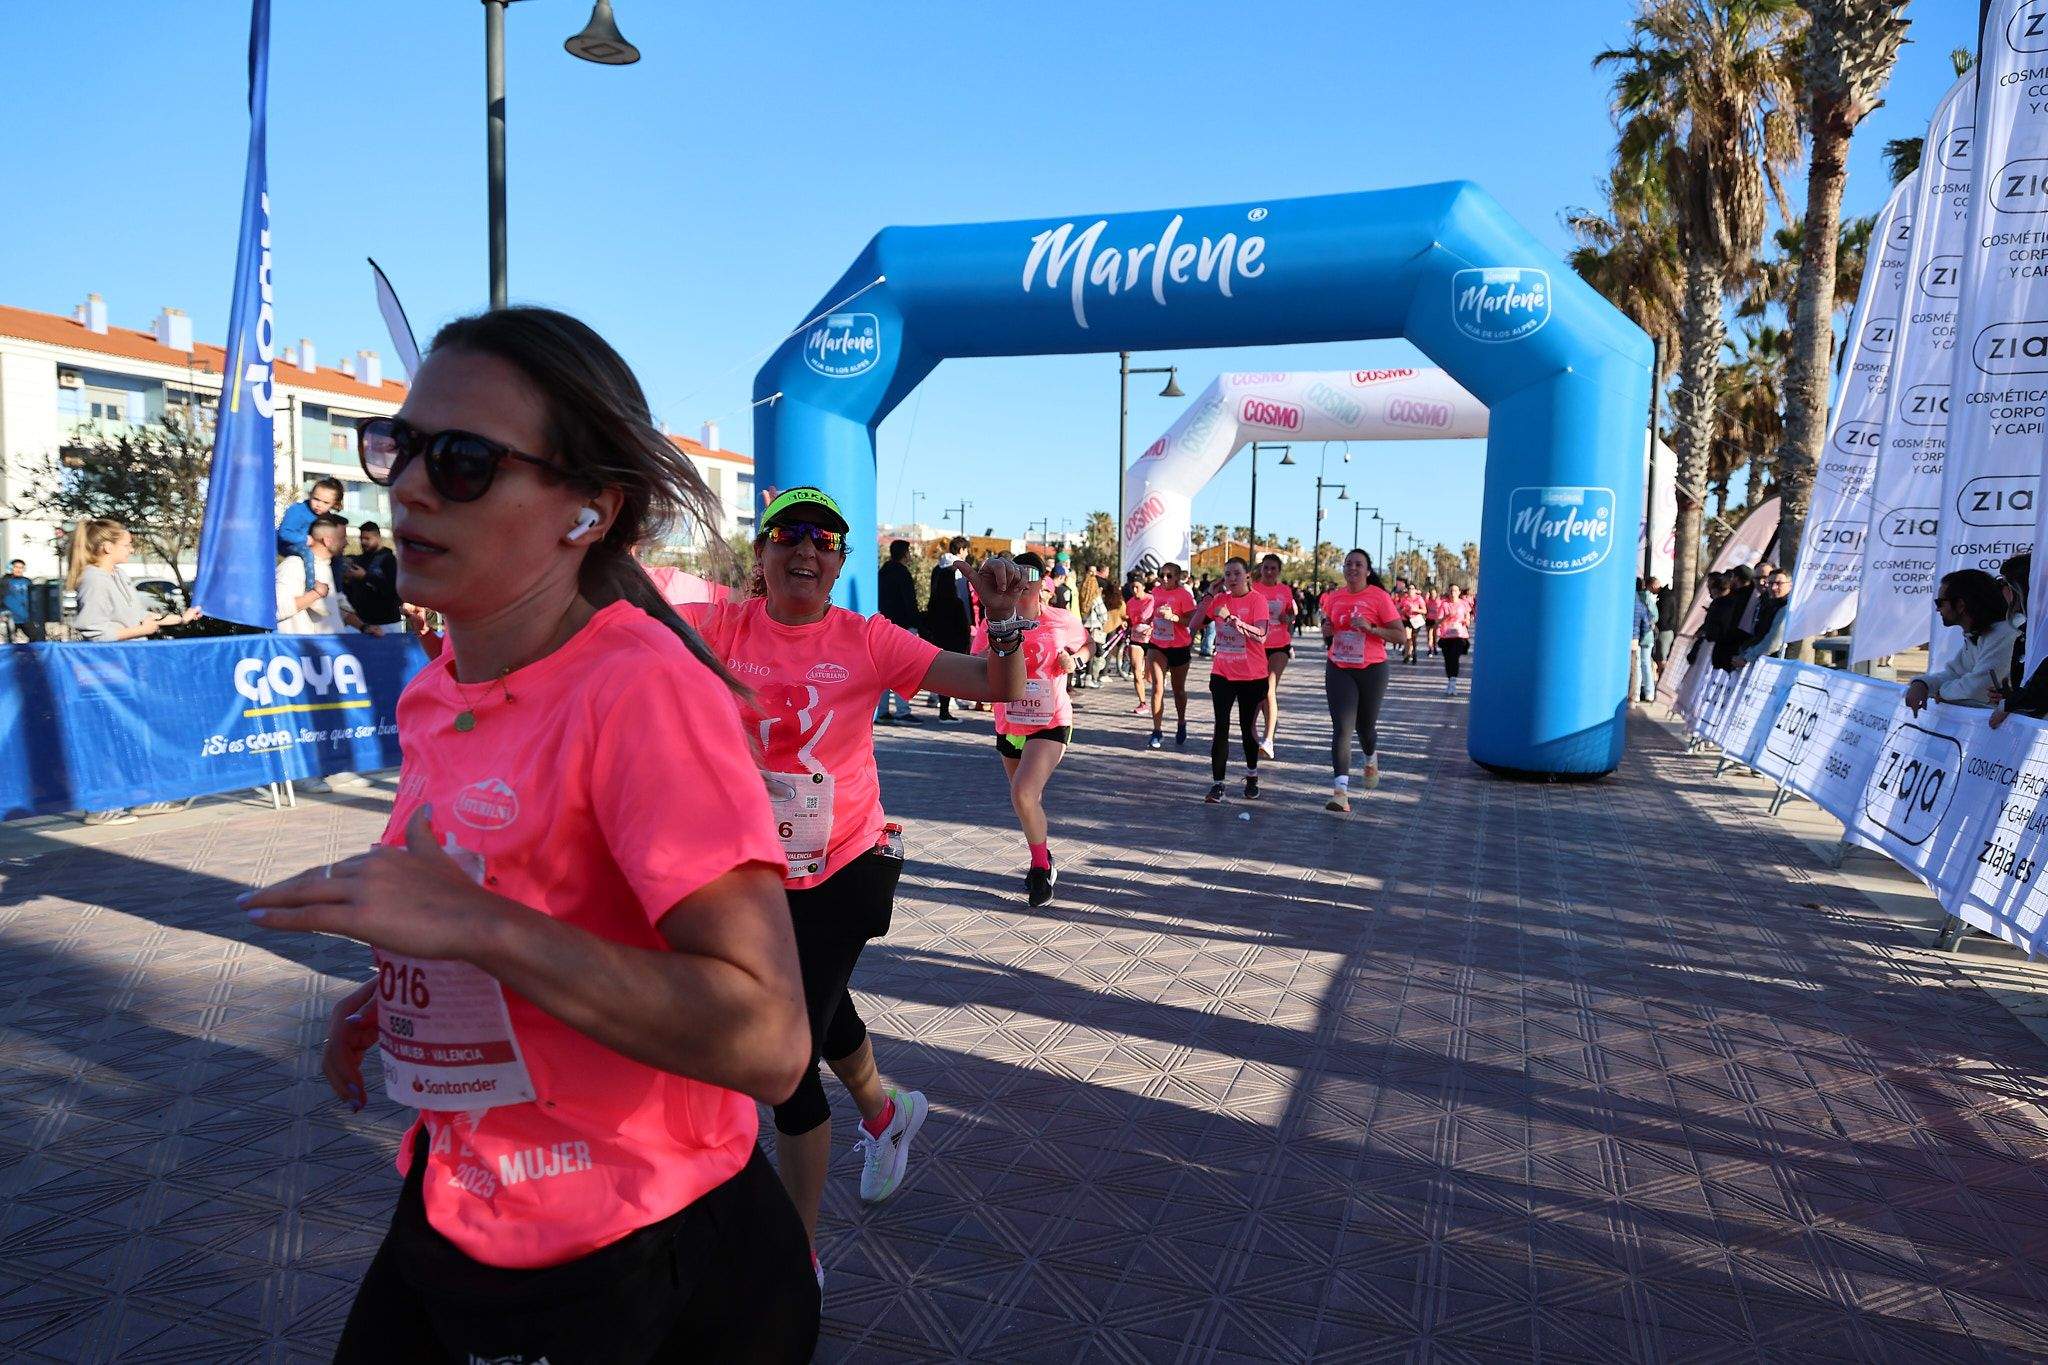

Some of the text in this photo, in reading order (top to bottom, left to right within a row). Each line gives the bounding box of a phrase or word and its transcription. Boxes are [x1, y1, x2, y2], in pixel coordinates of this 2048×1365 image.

[1022, 214, 1266, 330] Marlene
[1459, 283, 1545, 323] Marlene
[809, 328, 874, 360] Marlene
[1243, 400, 1299, 429] COSMO
[1389, 399, 1449, 427] COSMO
[1992, 424, 2001, 435] Y
[1514, 506, 1607, 550] Marlene
[1551, 559, 1570, 569] LOS
[1571, 551, 1599, 568] ALPES
[233, 654, 369, 706] GOYA
[1021, 699, 1041, 708] 016
[245, 730, 293, 750] GOYA
[330, 727, 354, 750] que
[354, 725, 377, 739] ser
[1977, 836, 2036, 884] ziaja.es
[424, 1078, 498, 1095] Santander
[498, 1140, 593, 1187] MUJER
